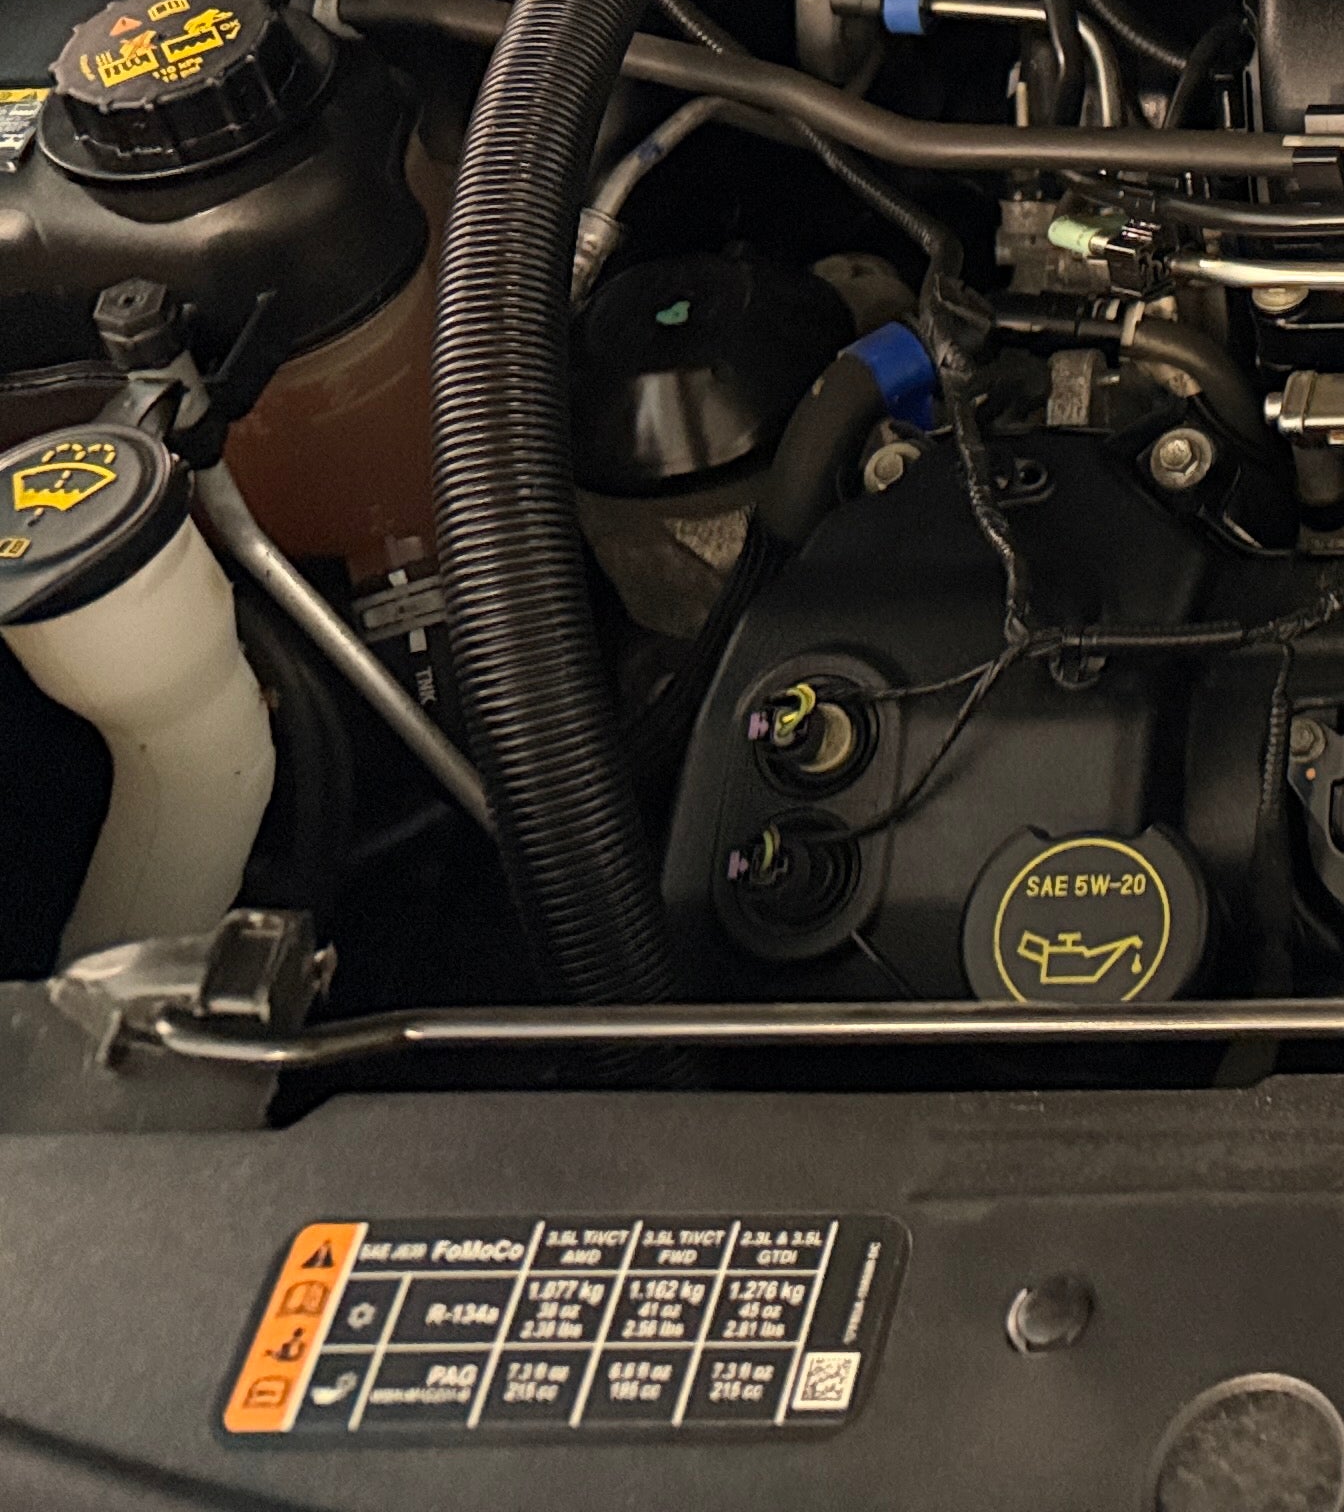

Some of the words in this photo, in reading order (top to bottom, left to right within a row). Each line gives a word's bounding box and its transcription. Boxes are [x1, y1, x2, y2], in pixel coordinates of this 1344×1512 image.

[219, 19, 239, 31] OK
[415, 665, 438, 706] TNK
[1026, 875, 1068, 898] SAE
[1074, 873, 1147, 897] 5W-20
[582, 1229, 630, 1247] TiVCT
[679, 1230, 725, 1246] TiVCT
[431, 1239, 525, 1262] FoMoCo
[560, 1249, 602, 1266] AWD
[657, 1249, 698, 1265] FWD
[578, 1280, 605, 1307] kg
[629, 1279, 680, 1301] 1.162
[680, 1280, 706, 1306] kg
[729, 1280, 779, 1301] 1.276
[779, 1280, 806, 1306] kg
[425, 1302, 500, 1326] R-134a
[637, 1302, 659, 1318] 41
[738, 1302, 760, 1318] 45
[761, 1305, 783, 1320] oz
[752, 1365, 774, 1382] oz
